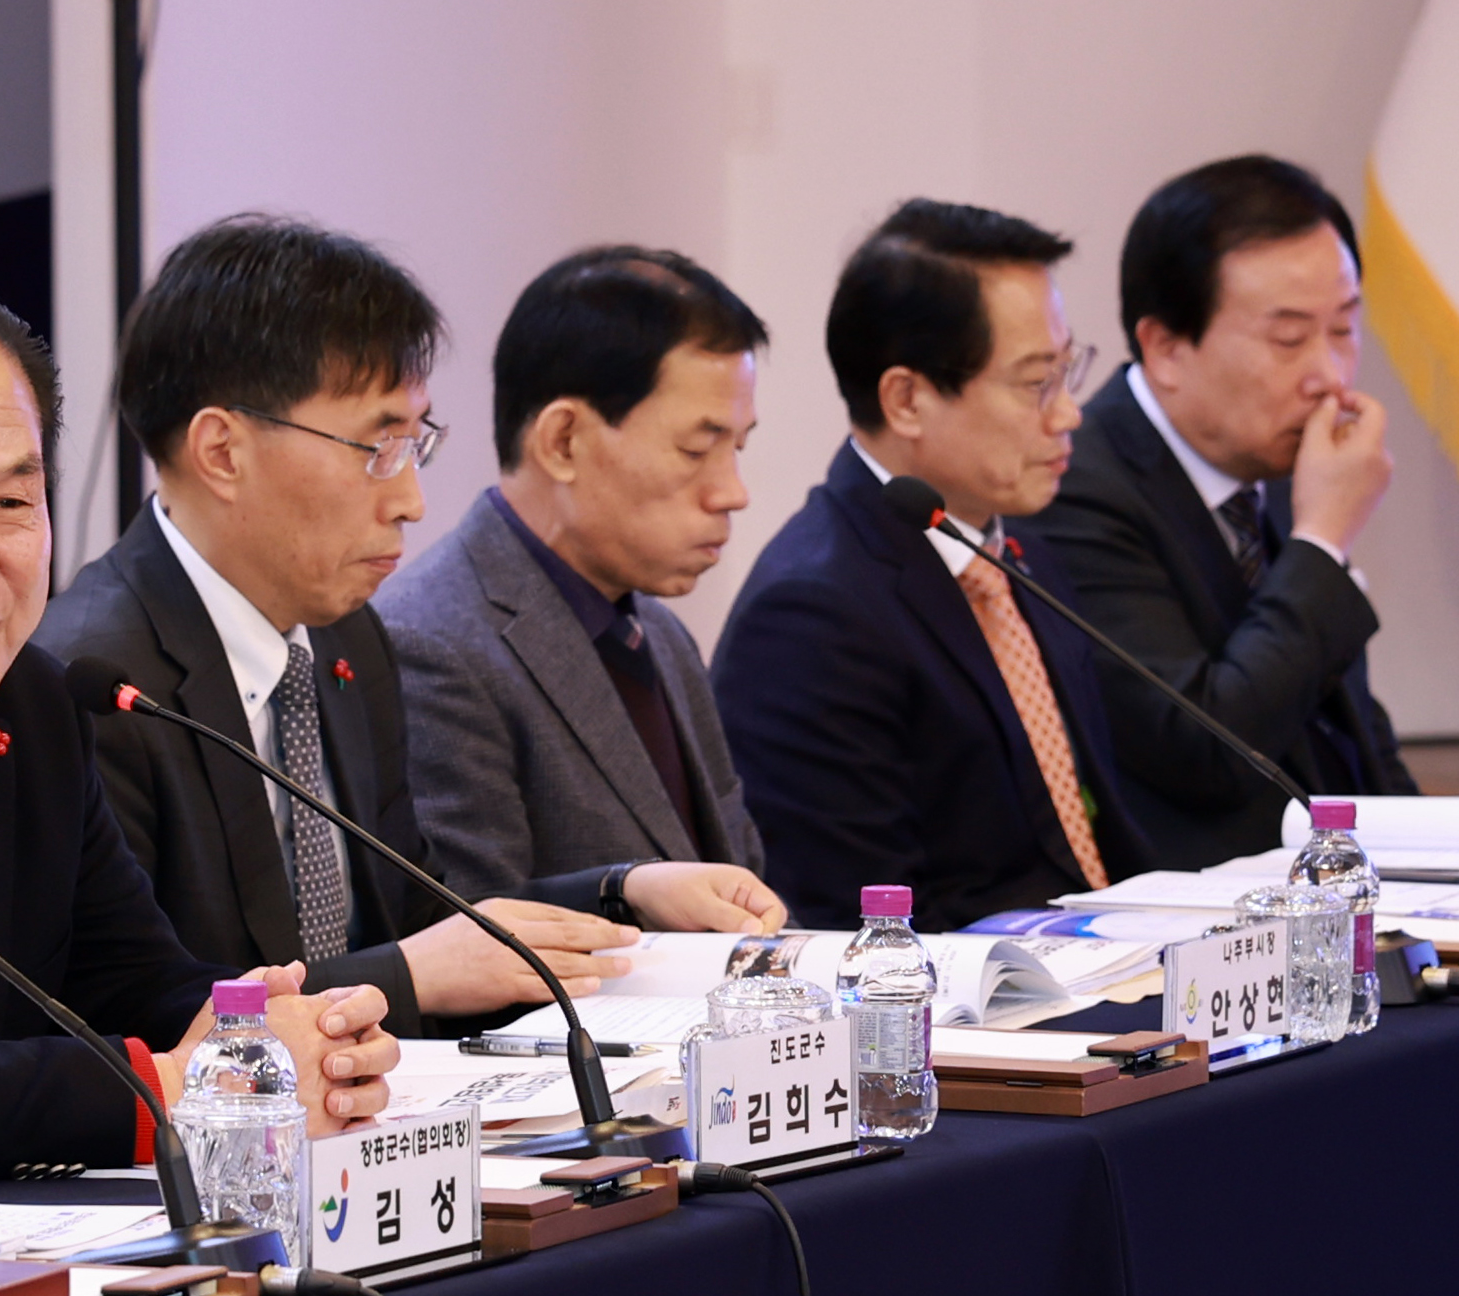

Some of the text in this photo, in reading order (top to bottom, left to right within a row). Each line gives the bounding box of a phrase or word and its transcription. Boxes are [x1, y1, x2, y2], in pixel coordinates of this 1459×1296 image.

[1223, 931, 1275, 964] 나주부시장
[1211, 975, 1283, 1038] 안상현
[770, 1031, 825, 1064] 진도군수
[748, 1078, 849, 1145] 김희수
[361, 1117, 471, 1168] 장흥군수(협의회장)
